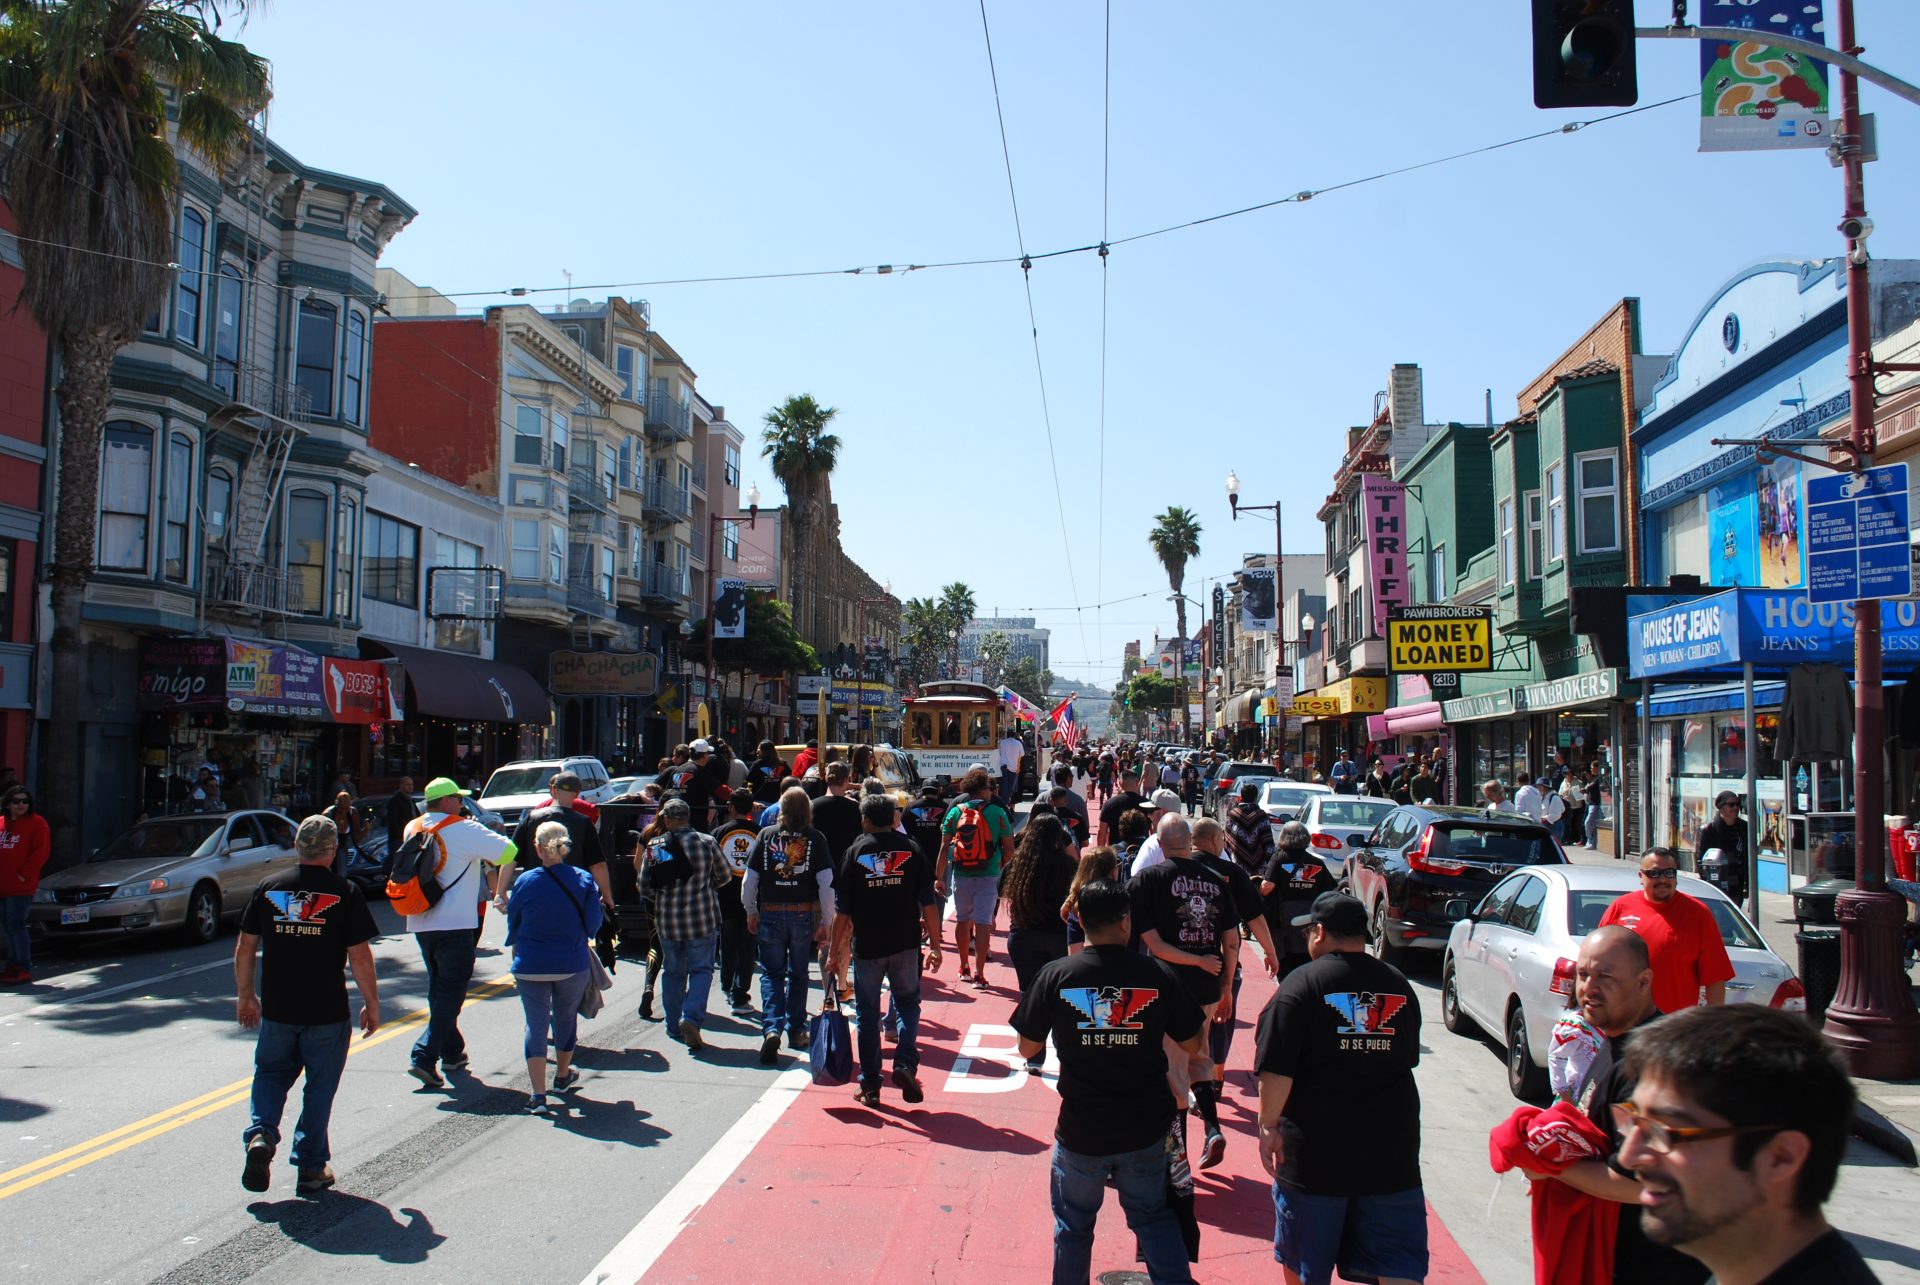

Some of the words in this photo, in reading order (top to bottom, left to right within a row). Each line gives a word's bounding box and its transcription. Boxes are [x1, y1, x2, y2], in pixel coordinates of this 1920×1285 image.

[1812, 513, 1828, 521] NOTICE
[1830, 533, 1855, 542] RECORDED
[1375, 496, 1402, 617] THRIFT
[1403, 607, 1484, 619] PAWNBROKERS
[1400, 623, 1479, 643] MONEY
[1643, 617, 1673, 649] HOUSE
[1673, 613, 1687, 643] OF
[1688, 606, 1720, 641] JEANS
[1760, 635, 1819, 651] JEANS
[1395, 644, 1484, 665] LOANED
[1643, 654, 1657, 668] MEN
[1660, 648, 1685, 665] WOMAN
[1688, 641, 1721, 660] CHILDREN
[228, 666, 256, 681] ATM
[554, 656, 586, 676] CHA
[587, 656, 619, 676] CHA
[620, 657, 653, 677] CHA
[345, 671, 376, 695] BOSS
[1433, 674, 1456, 686] 2318
[1514, 671, 1610, 709] PAWNBROKERS
[922, 753, 959, 761] Carpenters
[884, 878, 902, 887] PUEDE
[1171, 875, 1221, 898] Glaziers
[276, 924, 283, 933] SI
[286, 925, 295, 934] SE
[298, 926, 321, 936] PUEDE
[1082, 1034, 1091, 1046] SI
[1094, 1034, 1105, 1046] SE
[1109, 1034, 1139, 1046] PUEDE
[1340, 1039, 1349, 1051] SI
[1352, 1039, 1363, 1051] SE
[1366, 1039, 1392, 1052] PUEDE
